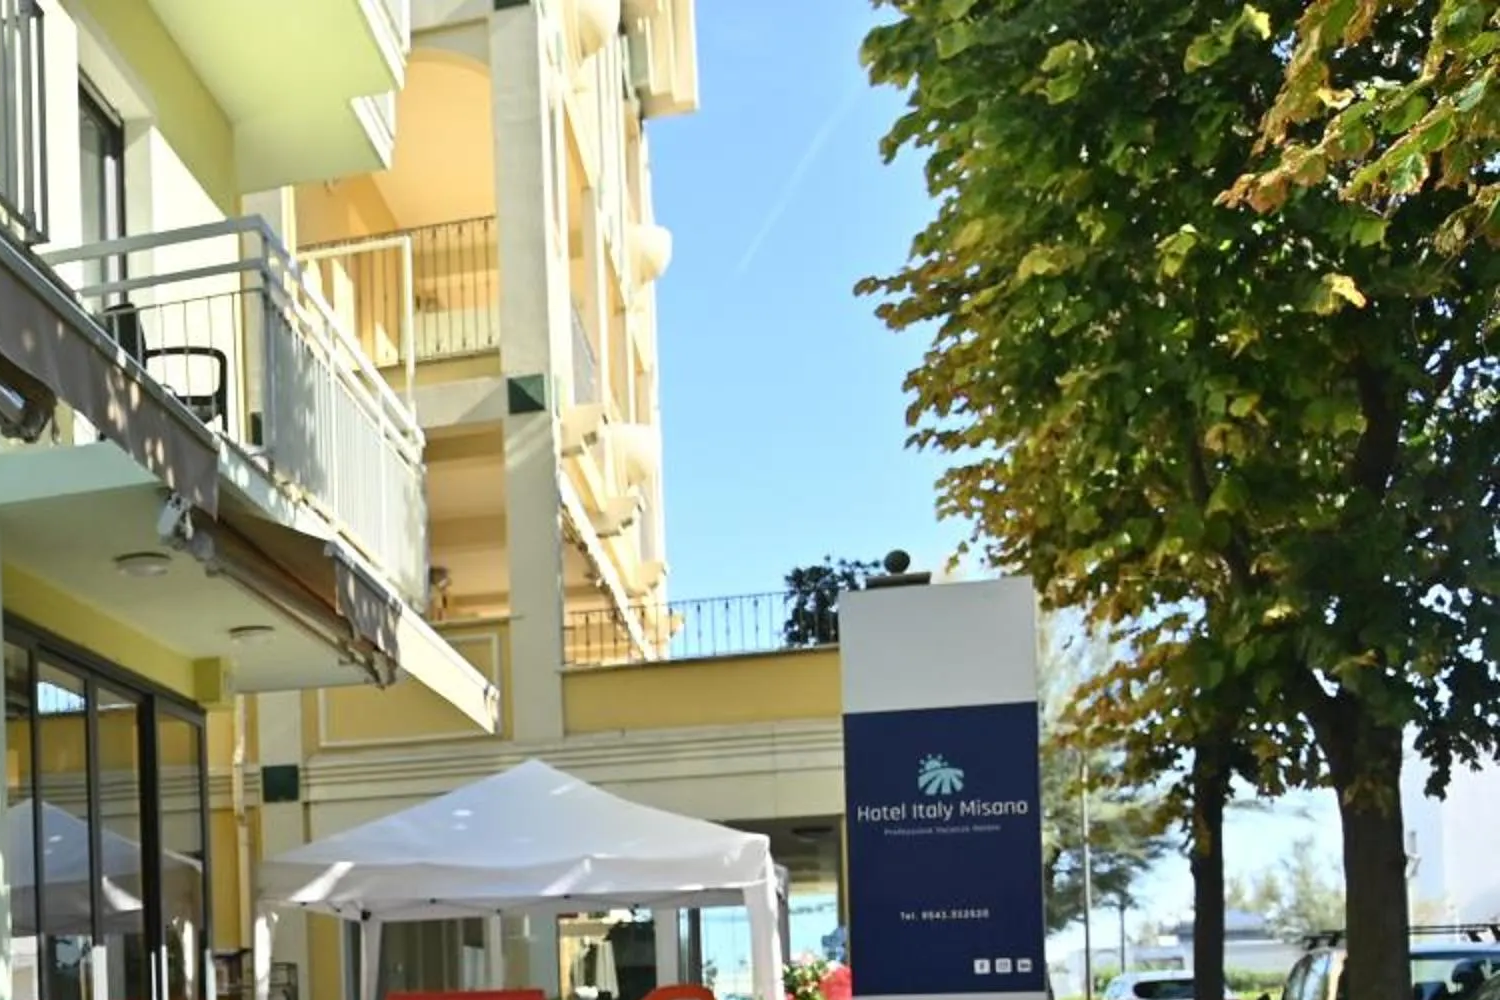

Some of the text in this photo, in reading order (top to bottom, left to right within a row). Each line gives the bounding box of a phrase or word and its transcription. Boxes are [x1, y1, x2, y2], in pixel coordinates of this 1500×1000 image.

[856, 799, 1029, 821] Hotel Italy Misano
